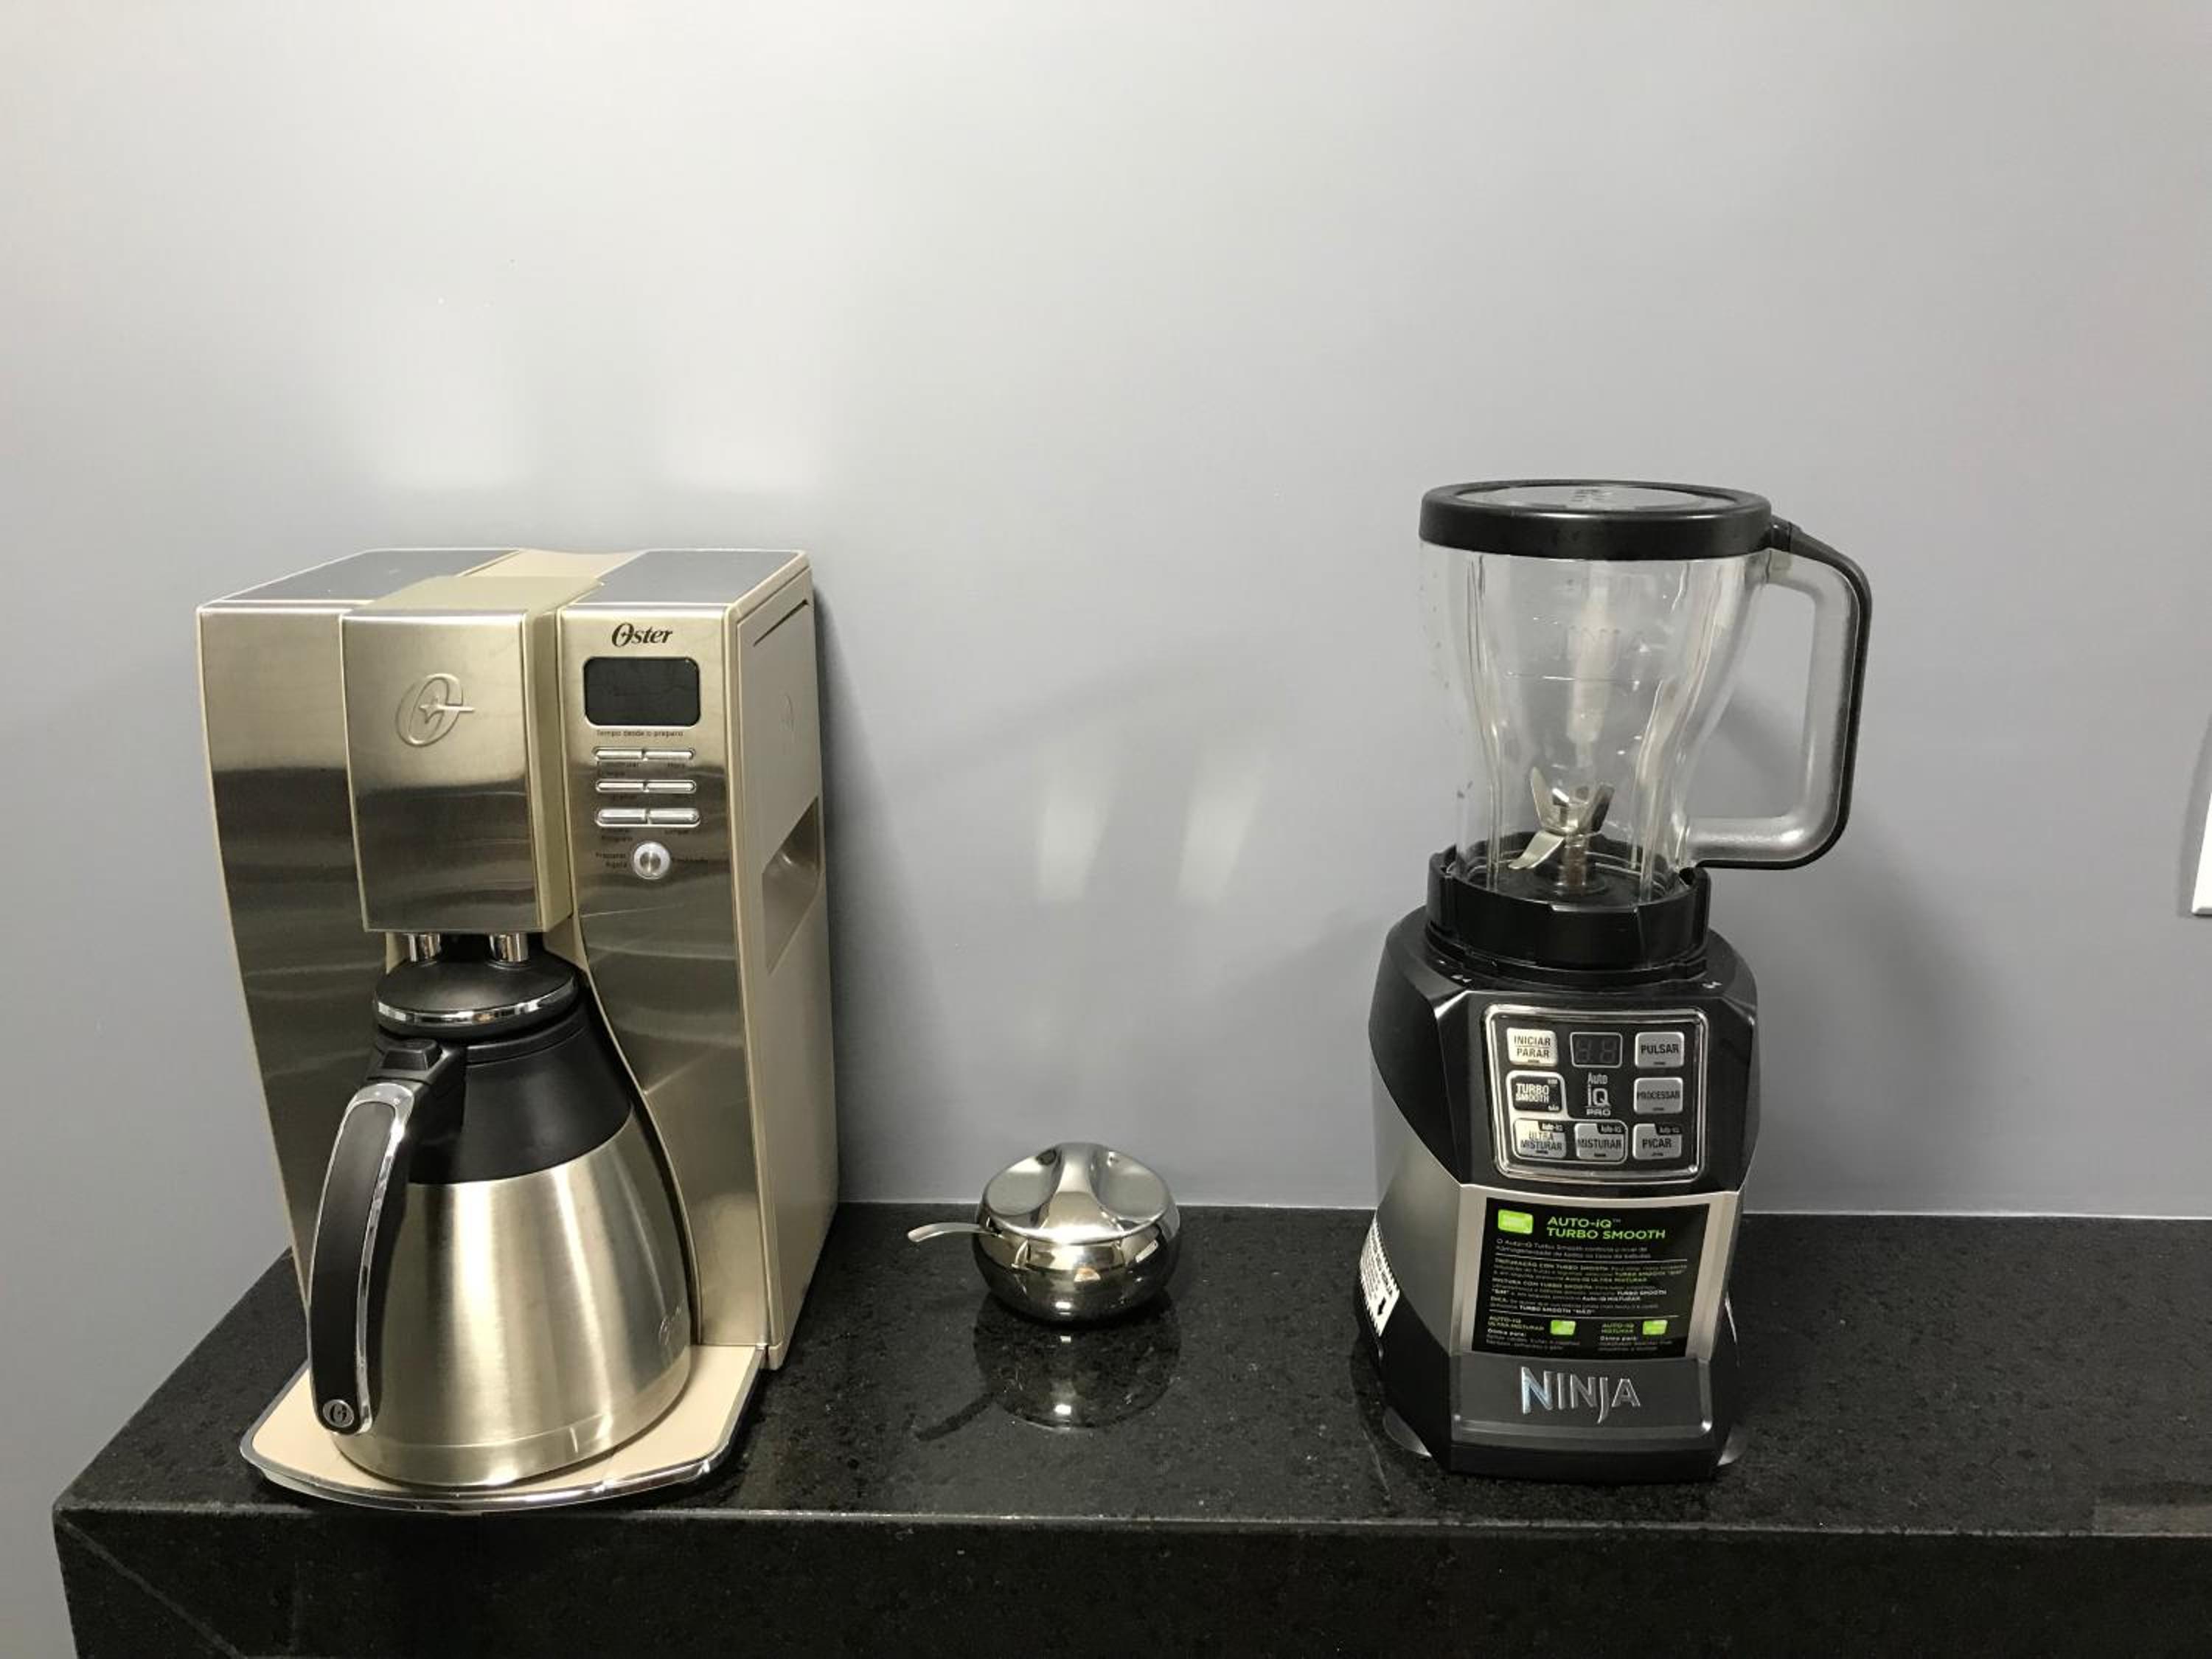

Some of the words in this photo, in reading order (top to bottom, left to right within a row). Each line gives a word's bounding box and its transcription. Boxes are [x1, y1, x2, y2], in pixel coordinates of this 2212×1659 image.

[611, 622, 673, 647] Oster
[1514, 1036, 1551, 1047] INICIAR
[1517, 1048, 1551, 1058] PARAR
[1641, 1043, 1679, 1054] PULSAR
[1515, 1083, 1549, 1095] TURBO
[1515, 1093, 1549, 1103] SMOOTH
[1637, 1091, 1680, 1100] PROCESSAR
[1528, 1131, 1554, 1140] ULTRA
[1520, 1139, 1562, 1150] MISTURAR
[1577, 1138, 1622, 1149] MISTURAR
[1642, 1138, 1672, 1149] PICAR
[1546, 1227, 1599, 1239] TURBO
[1601, 1229, 1666, 1239] SMOOTH
[1520, 1366, 1641, 1424] NINJA
